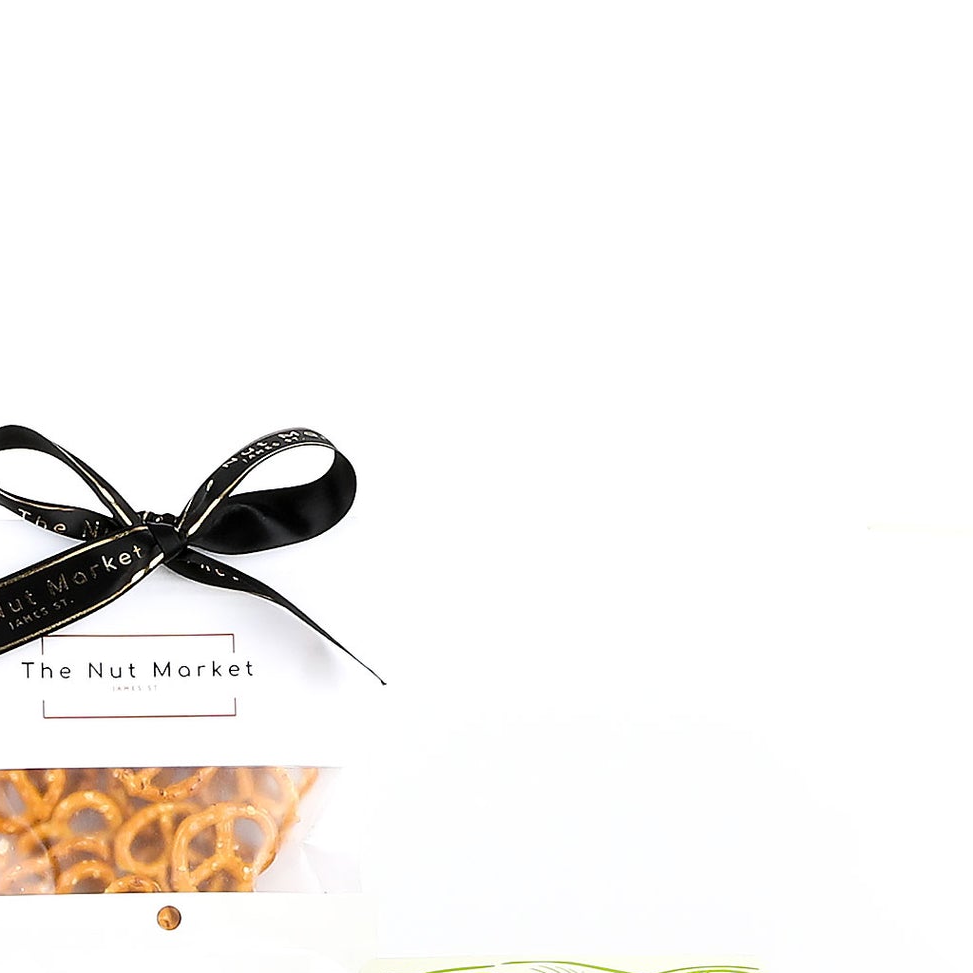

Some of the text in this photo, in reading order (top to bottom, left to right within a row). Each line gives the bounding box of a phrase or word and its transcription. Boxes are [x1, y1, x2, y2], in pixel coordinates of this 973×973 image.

[46, 545, 143, 596] Market
[21, 660, 254, 679] The Nut Market
